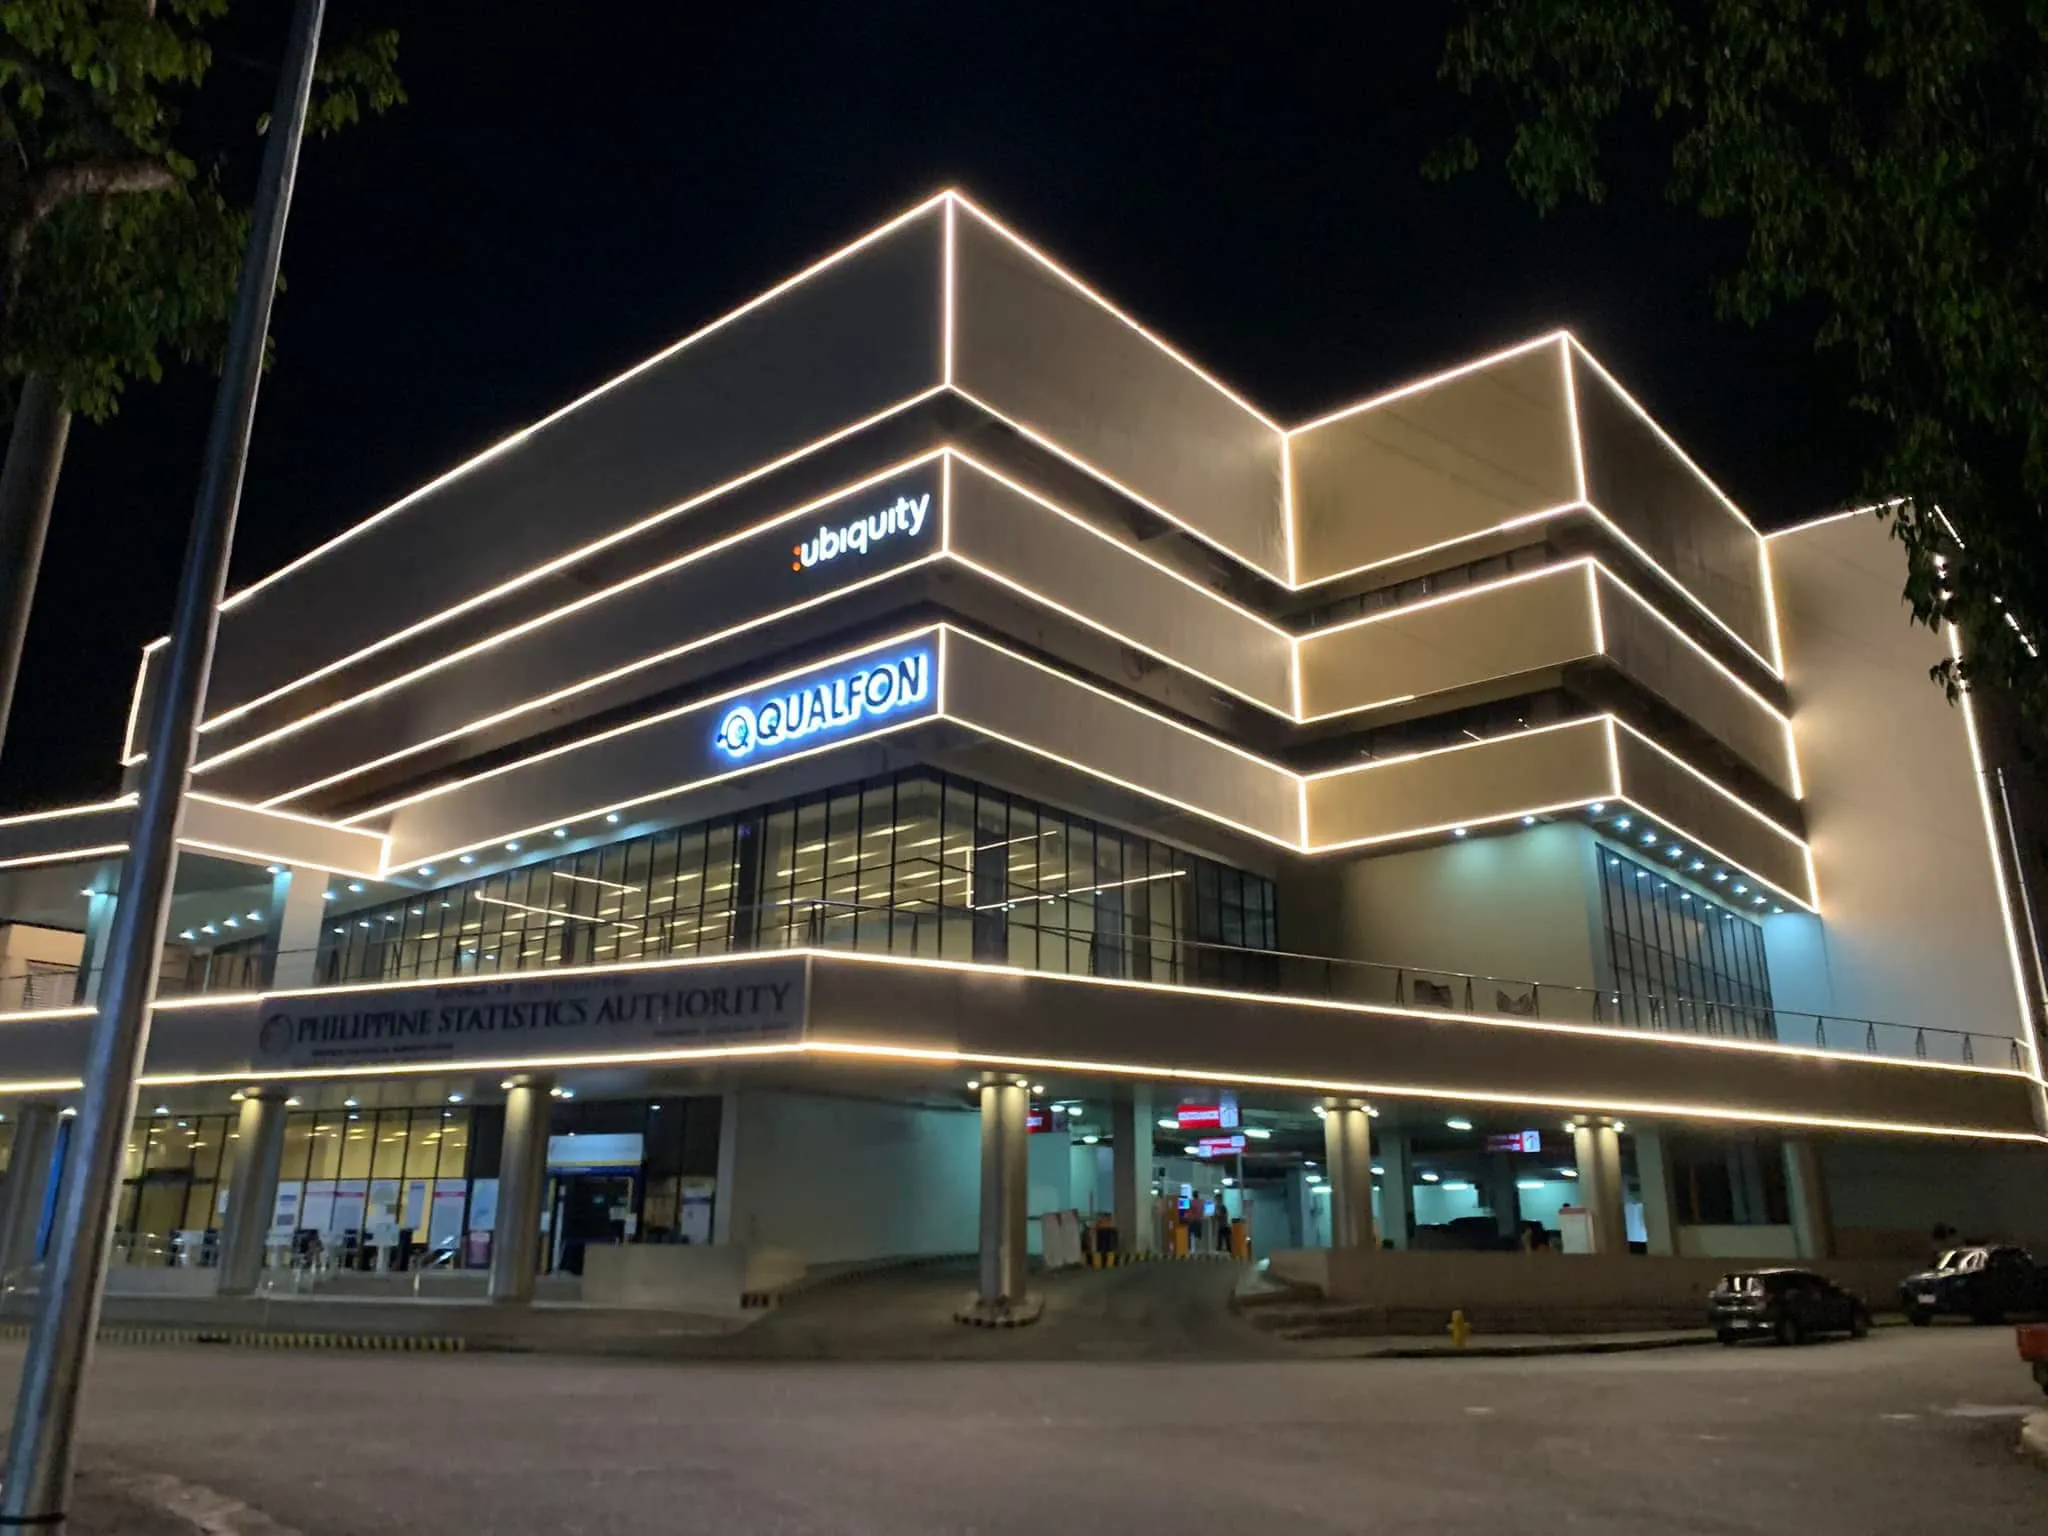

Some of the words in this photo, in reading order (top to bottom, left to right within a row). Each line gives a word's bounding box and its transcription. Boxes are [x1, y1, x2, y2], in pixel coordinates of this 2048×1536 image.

[297, 1006, 432, 1043] PHILIPPINE
[438, 996, 588, 1033] STATISTICS
[595, 981, 792, 1025] AUTHORITY
